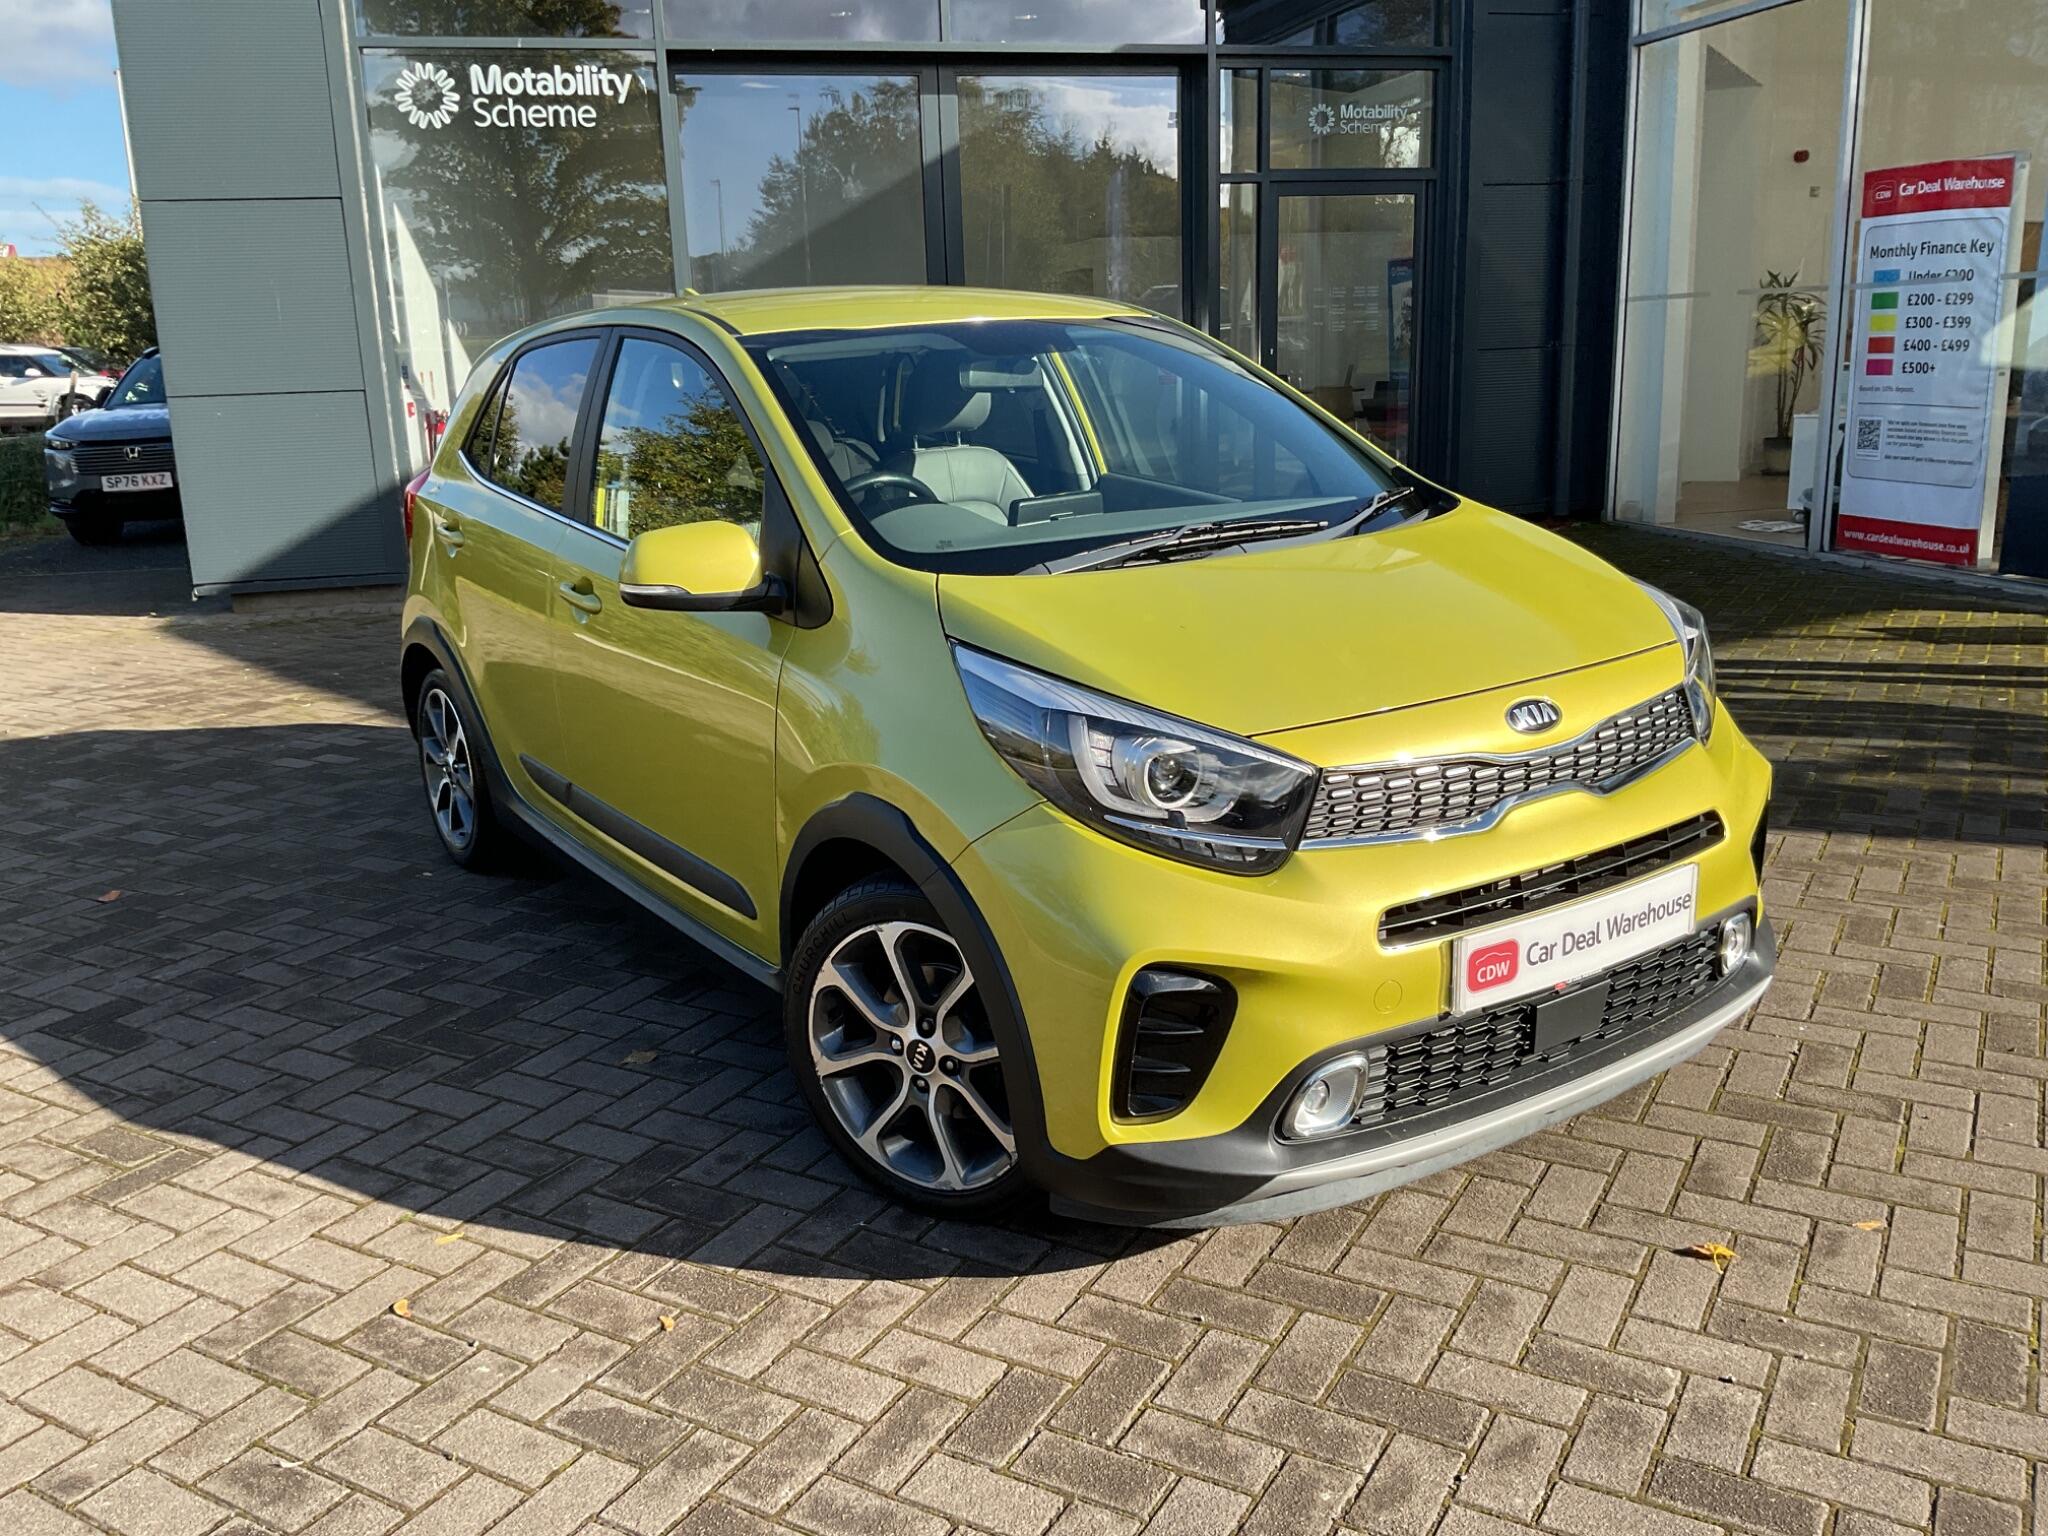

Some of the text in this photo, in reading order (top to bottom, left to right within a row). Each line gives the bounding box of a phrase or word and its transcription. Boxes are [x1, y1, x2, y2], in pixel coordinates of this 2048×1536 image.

[469, 63, 632, 104] Motability
[472, 97, 597, 128] Scheme
[1340, 104, 1408, 121] Motability
[1340, 120, 1391, 134] Scheme
[1899, 176, 2005, 196] Car Deal Warehouse
[1869, 239, 1995, 260] Monthly Finance Key
[1907, 293, 1935, 306] £200
[1945, 292, 1974, 305] £299
[1905, 316, 1933, 329] £300
[1943, 316, 1971, 329] £399
[1903, 338, 1931, 352] £400
[1941, 338, 1970, 352] £499
[1901, 361, 1936, 374] £500+
[106, 474, 167, 489] SP76 KXZ
[1512, 702, 1557, 727] KIA
[1526, 892, 1692, 966] Car Deal Warehouse
[1476, 960, 1511, 984] CDW
[913, 1042, 929, 1069] KIA
